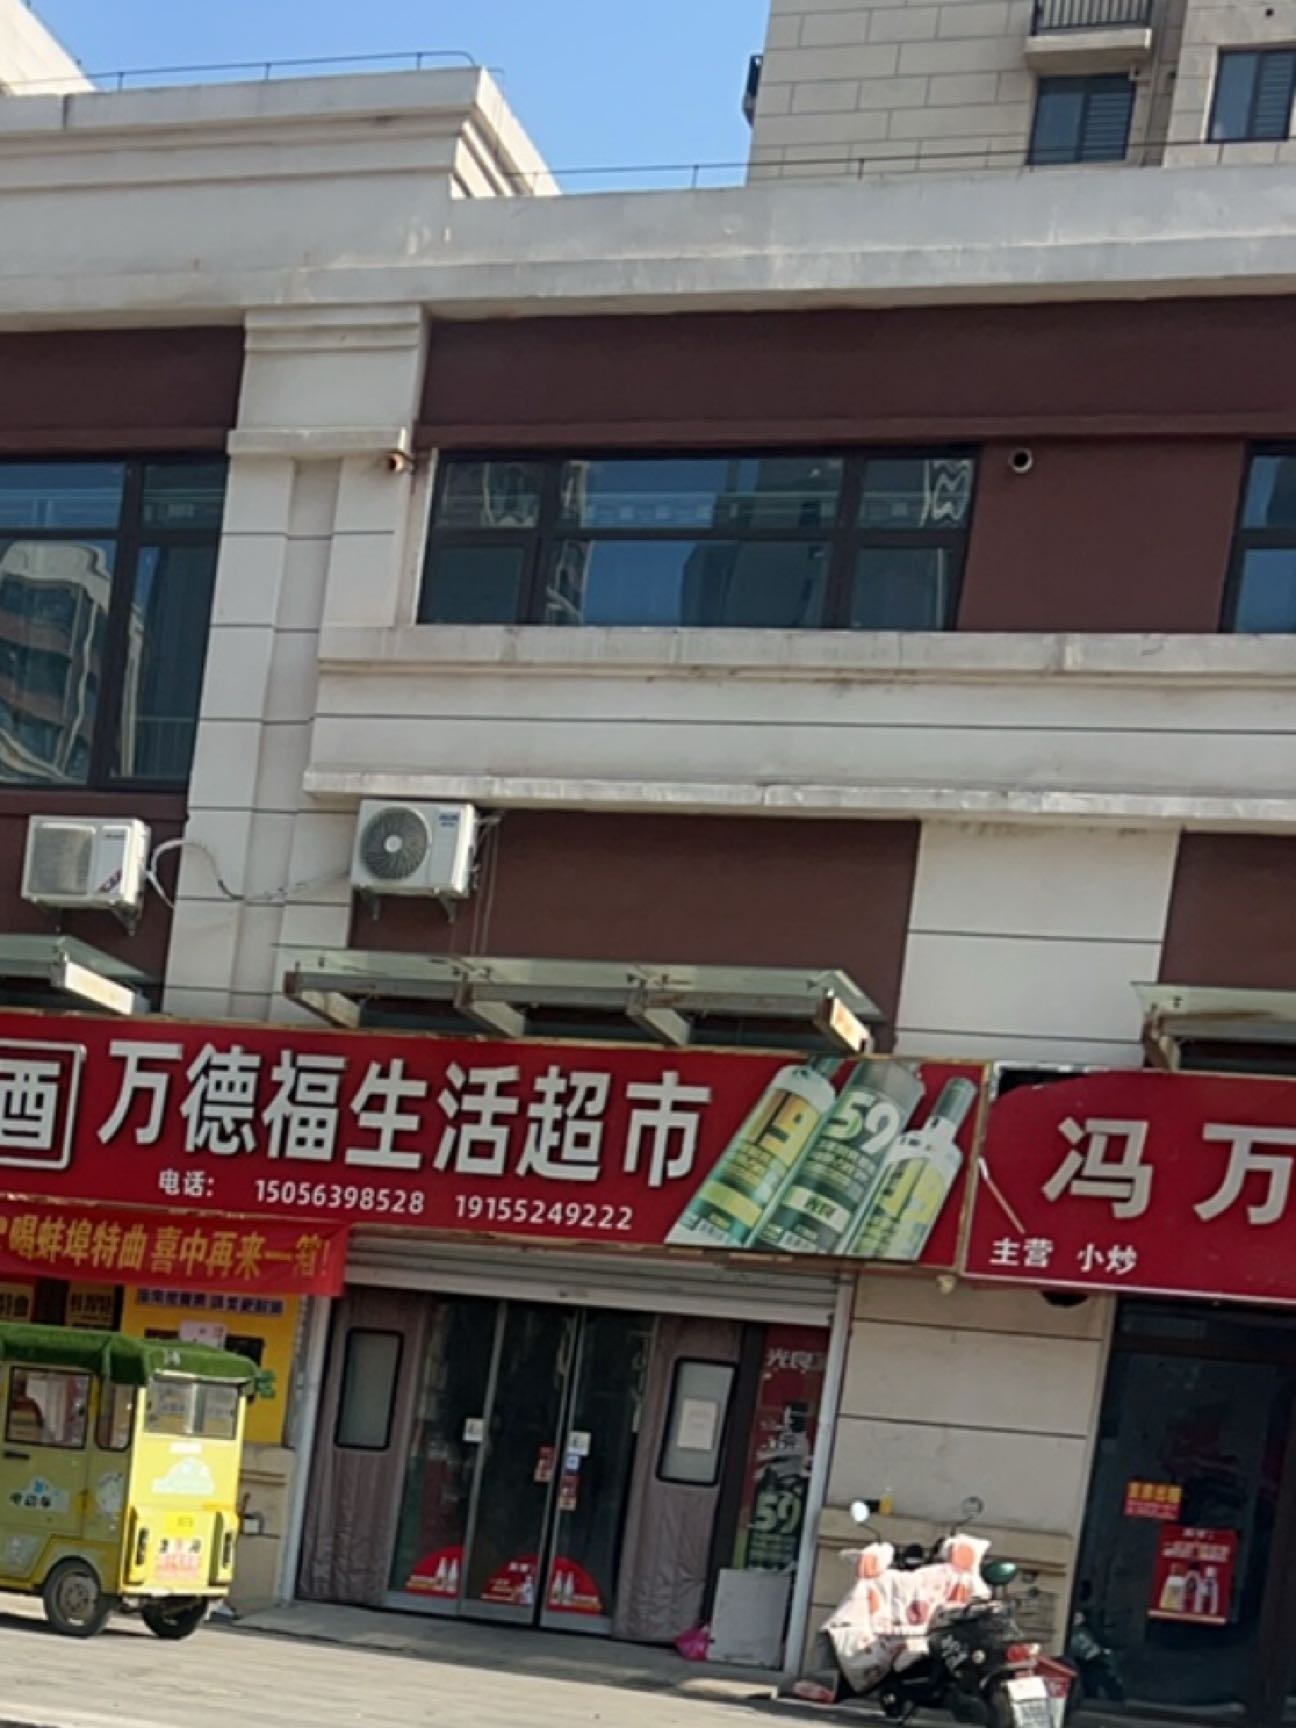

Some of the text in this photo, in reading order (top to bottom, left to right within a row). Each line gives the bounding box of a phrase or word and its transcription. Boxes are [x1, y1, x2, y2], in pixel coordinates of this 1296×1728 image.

[97, 1039, 712, 1189] 万德福生活超市
[824, 1090, 901, 1155] 59
[255, 1179, 425, 1215] 15056398528
[455, 1194, 634, 1230] 19155249222
[988, 1238, 1137, 1275] 主营 小炒
